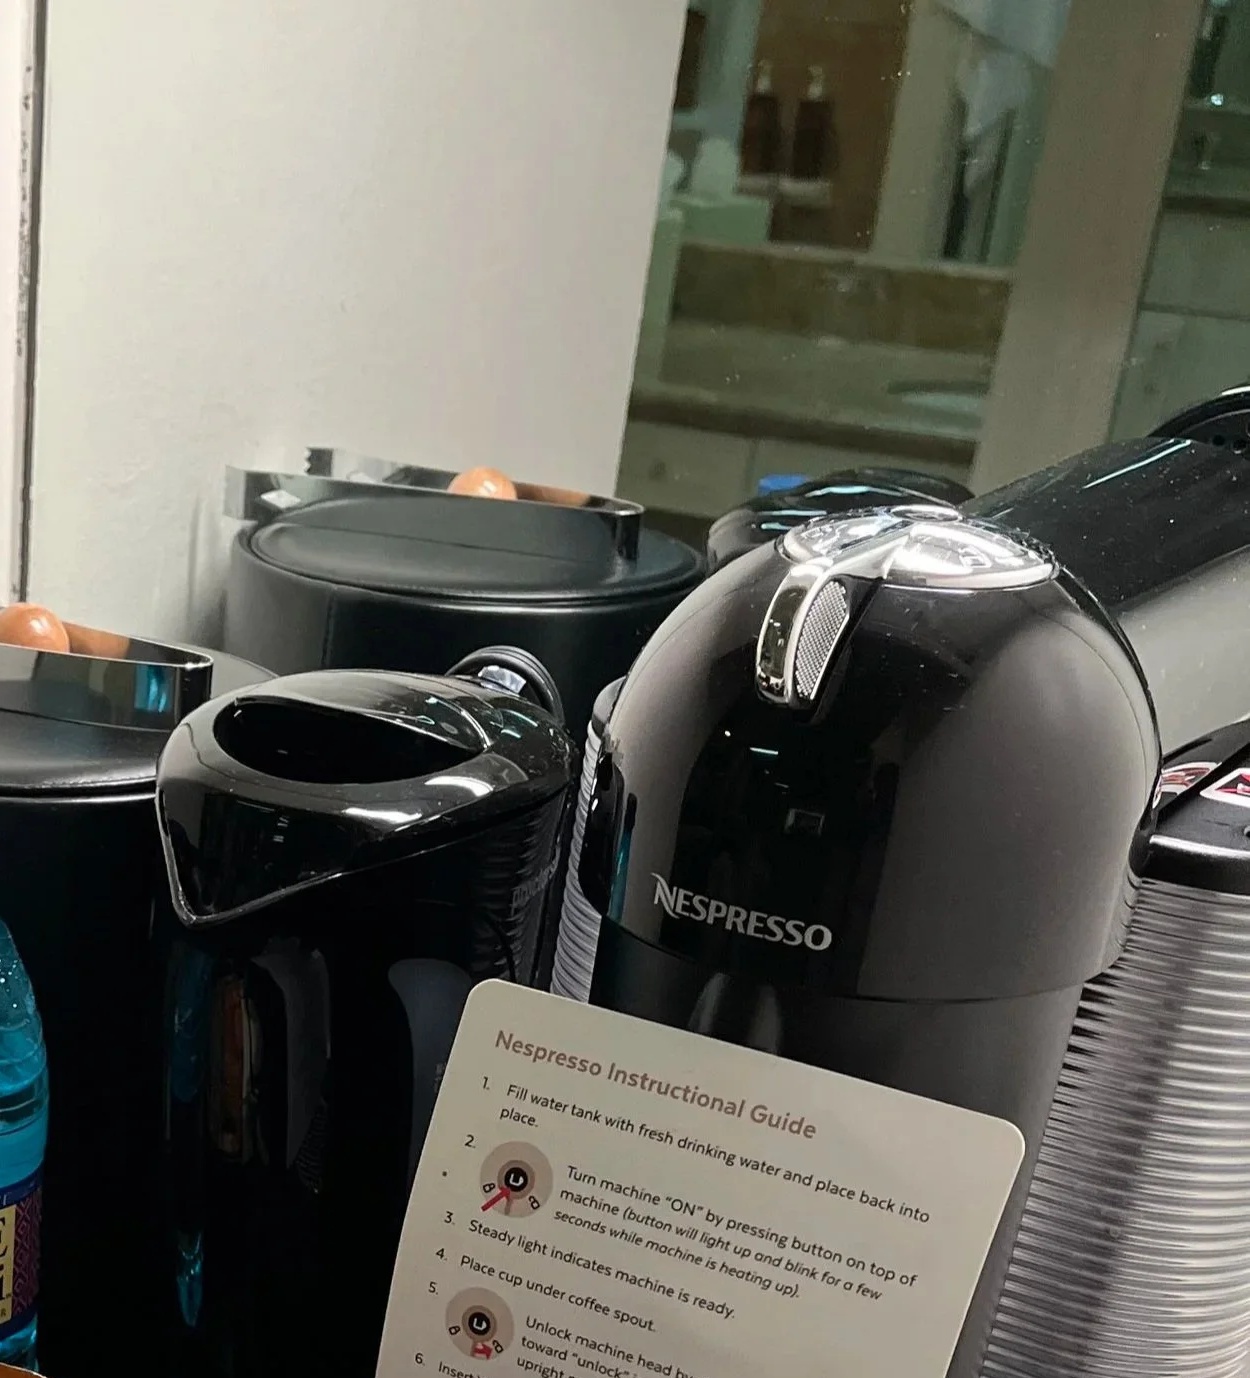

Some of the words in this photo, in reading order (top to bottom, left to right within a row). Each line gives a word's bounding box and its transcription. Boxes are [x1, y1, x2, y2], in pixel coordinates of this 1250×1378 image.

[651, 871, 833, 952] NESPRESSO
[494, 1029, 603, 1077] Nespresso
[606, 1061, 747, 1119] Instructional
[748, 1103, 817, 1140] Guide
[498, 1106, 539, 1129] place.
[505, 1083, 530, 1103] Fill
[529, 1093, 570, 1114] water
[569, 1102, 603, 1125] tank
[604, 1115, 636, 1135] with
[637, 1122, 675, 1146] fresh
[676, 1135, 738, 1168] drinking
[738, 1155, 783, 1177] water
[781, 1169, 815, 1188] and
[813, 1178, 857, 1201] place
[858, 1189, 897, 1214] back
[897, 1201, 931, 1224] into
[467, 1218, 517, 1248] Steady
[516, 1234, 549, 1257] light
[549, 1245, 613, 1278] indicates
[613, 1269, 676, 1299] machine
[676, 1287, 691, 1304] is
[691, 1295, 739, 1322] ready.
[552, 1209, 608, 1235] seconds
[608, 1227, 645, 1247] while
[643, 1239, 704, 1267] machine
[703, 1255, 718, 1271] is
[717, 1260, 774, 1292] heating
[773, 1281, 800, 1299] up).
[558, 1188, 621, 1217] machine
[621, 1205, 674, 1234] (button
[674, 1225, 700, 1242] will
[697, 1230, 732, 1253] light
[731, 1244, 753, 1260] up
[753, 1251, 785, 1269] and
[783, 1257, 820, 1281] blink
[819, 1270, 843, 1288] for
[842, 1280, 855, 1292] a
[854, 1281, 884, 1301] few
[566, 1164, 598, 1187] Turn
[598, 1178, 662, 1207] machine
[704, 1207, 725, 1229] by
[724, 1218, 790, 1250] pressing
[789, 1234, 844, 1265] button
[845, 1256, 867, 1273] on
[868, 1261, 897, 1283] top
[898, 1273, 919, 1288] of
[459, 1253, 497, 1278] Place
[497, 1269, 524, 1289] cup
[525, 1278, 567, 1302] under
[567, 1293, 612, 1317] coffee
[612, 1308, 658, 1334] spout.
[520, 1334, 570, 1362] toward
[524, 1314, 573, 1343] Unlock
[573, 1334, 635, 1365] machine
[635, 1352, 674, 1378] head
